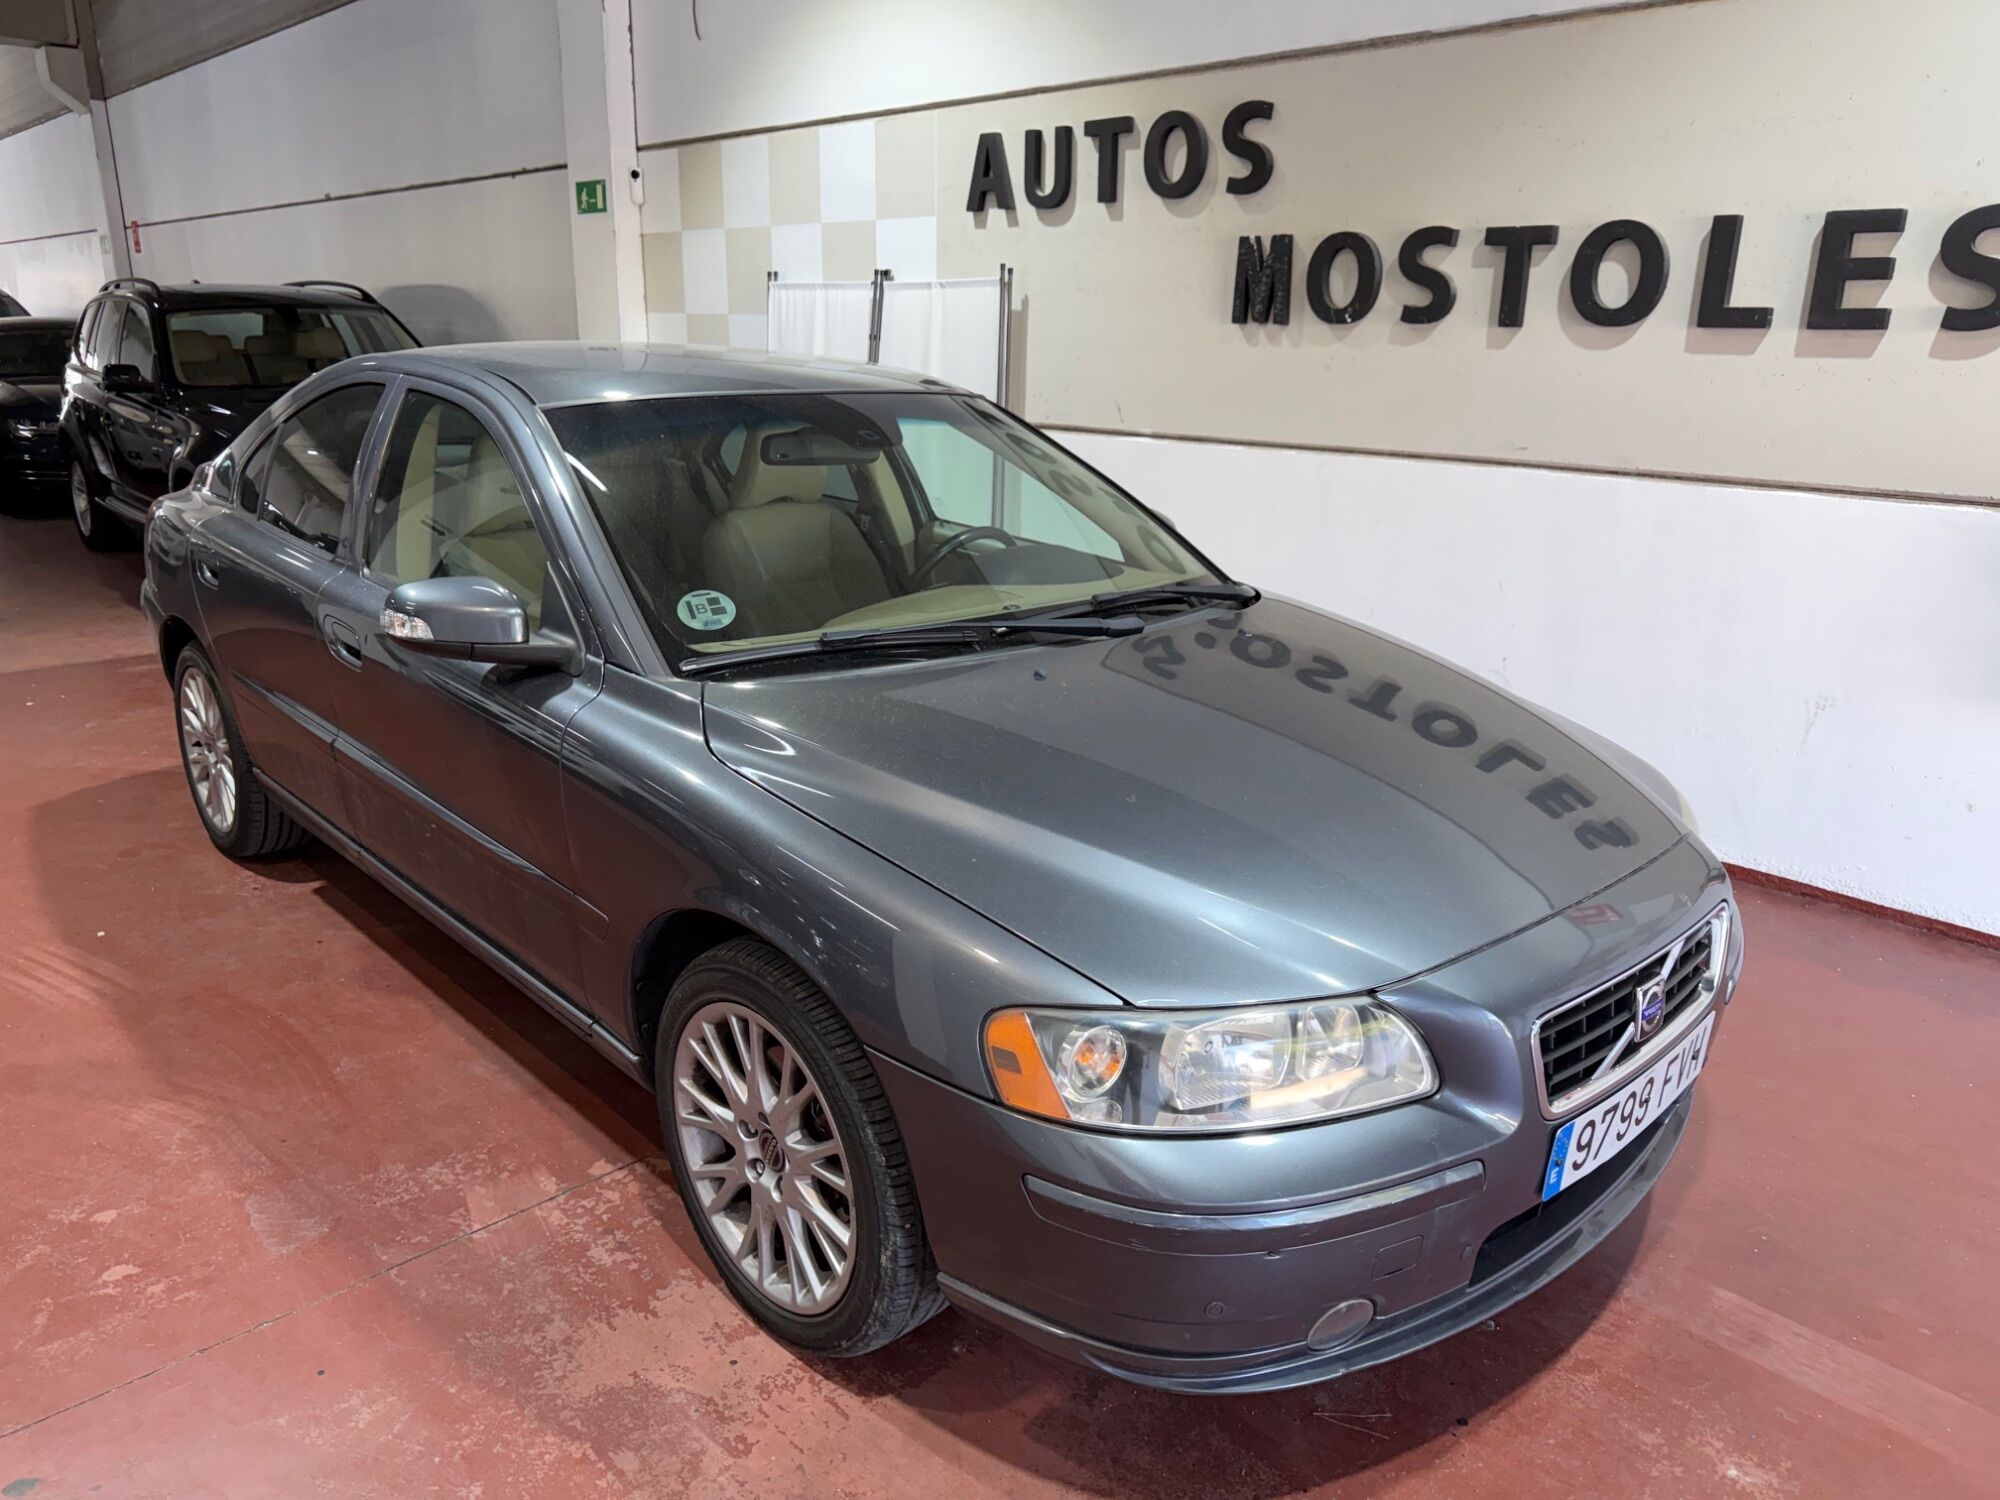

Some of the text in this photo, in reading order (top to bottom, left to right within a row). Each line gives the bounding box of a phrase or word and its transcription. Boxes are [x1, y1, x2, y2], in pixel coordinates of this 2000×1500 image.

[966, 100, 1276, 214] AUTOS
[1231, 203, 2000, 332] MOSTOLES
[1572, 1025, 1708, 1171] 9799 FVH
[1549, 1167, 1560, 1185] E
